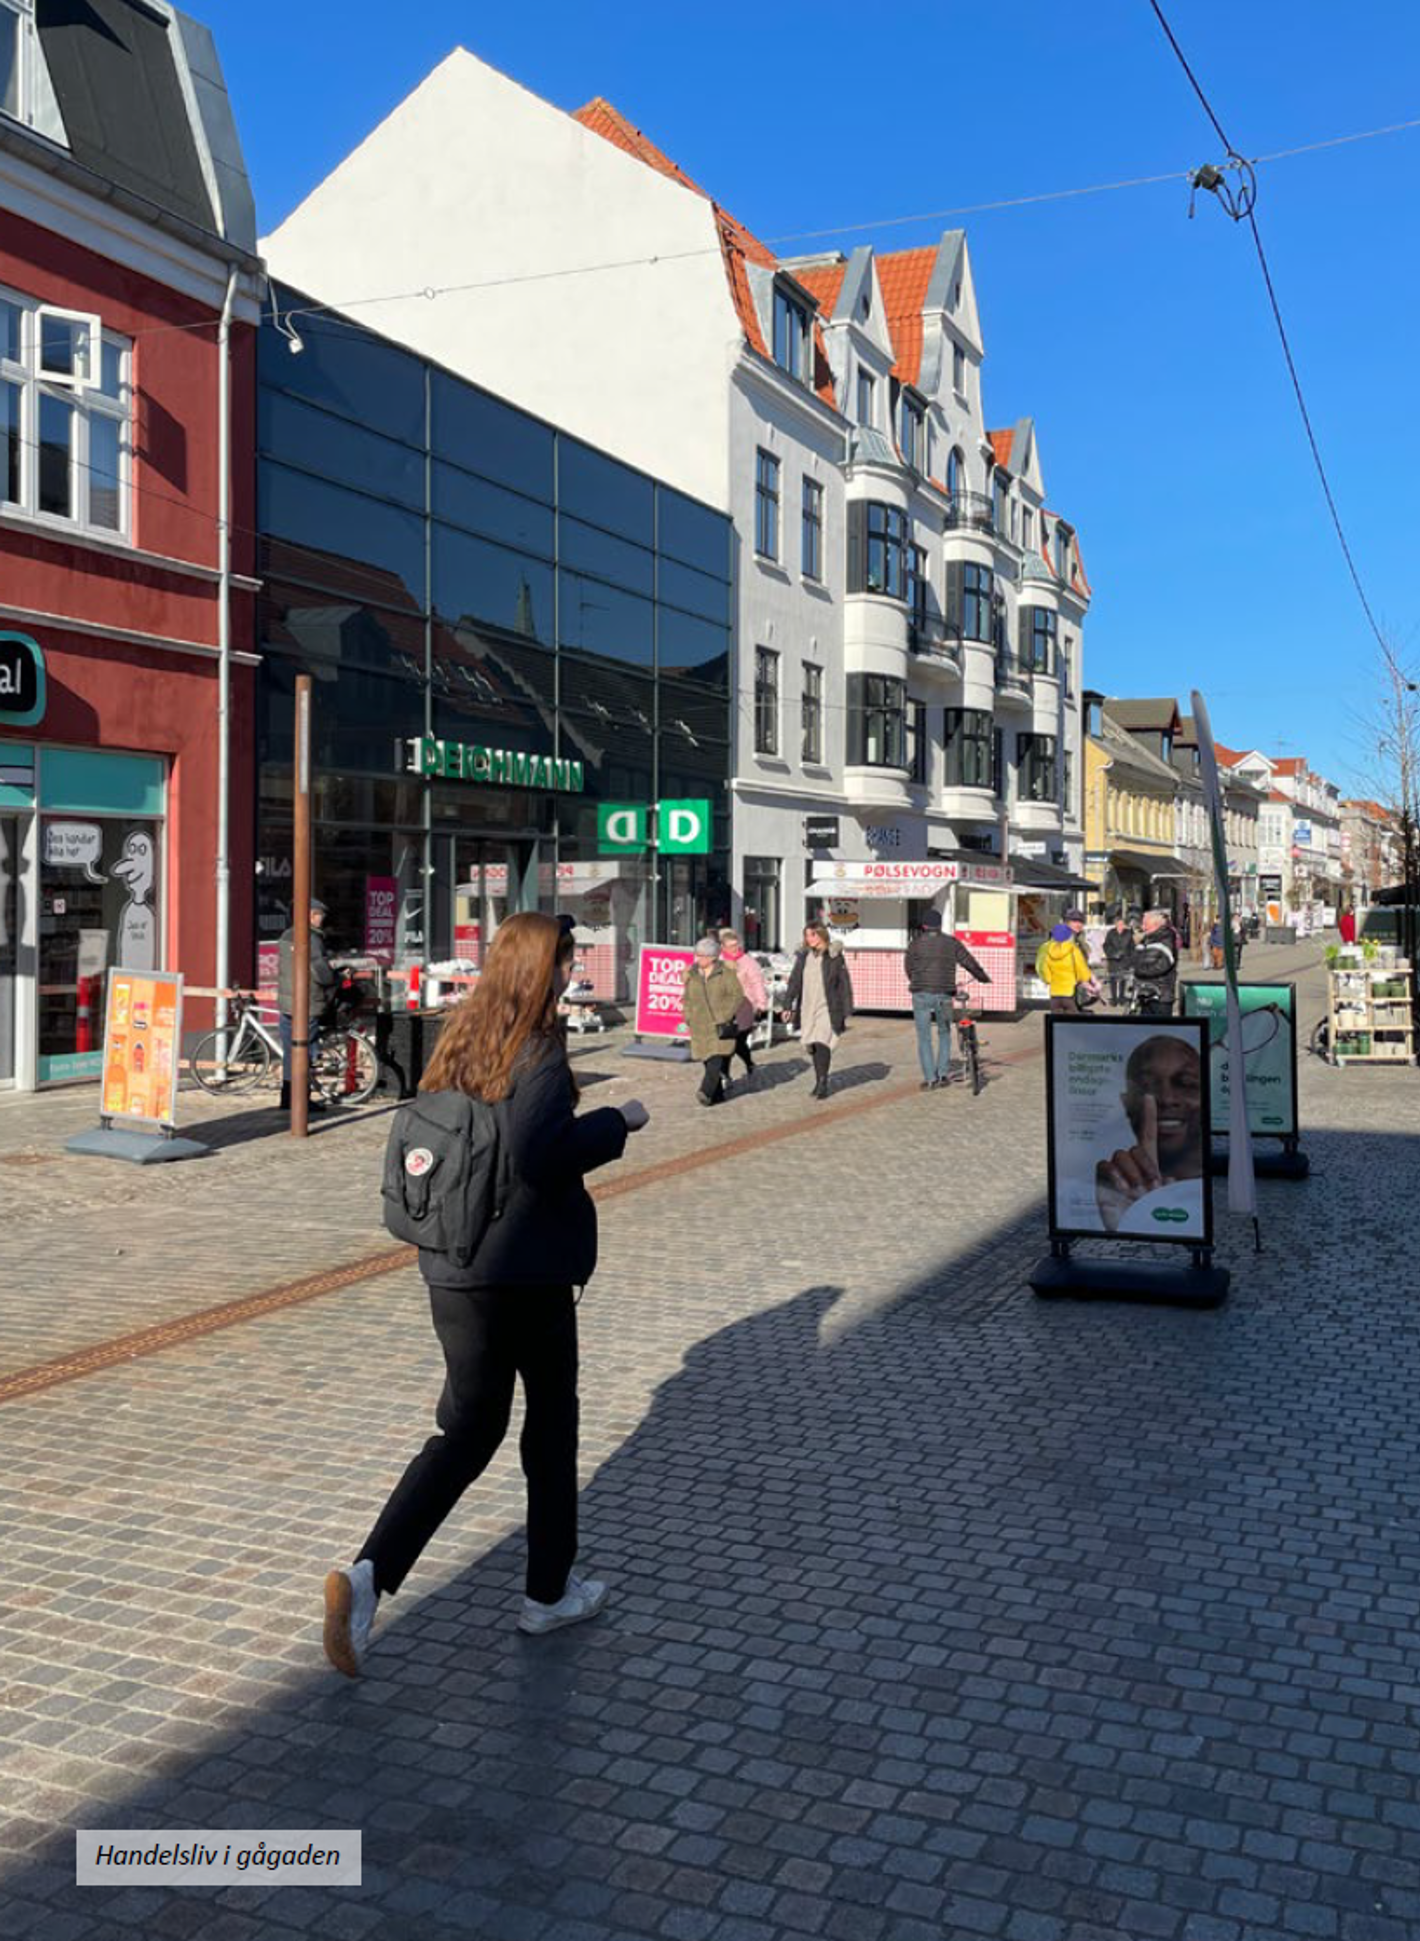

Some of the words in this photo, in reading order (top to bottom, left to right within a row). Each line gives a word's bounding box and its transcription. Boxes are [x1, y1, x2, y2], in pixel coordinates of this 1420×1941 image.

[418, 737, 583, 792] DEICHMANN
[669, 809, 700, 843] D
[864, 864, 956, 878] PØLSEVOGN
[369, 890, 395, 905] TOP
[369, 906, 392, 917] DEAL
[369, 929, 393, 944] 20%
[650, 957, 685, 973] TOP
[649, 972, 684, 985] DEAL
[648, 994, 684, 1011] 20%
